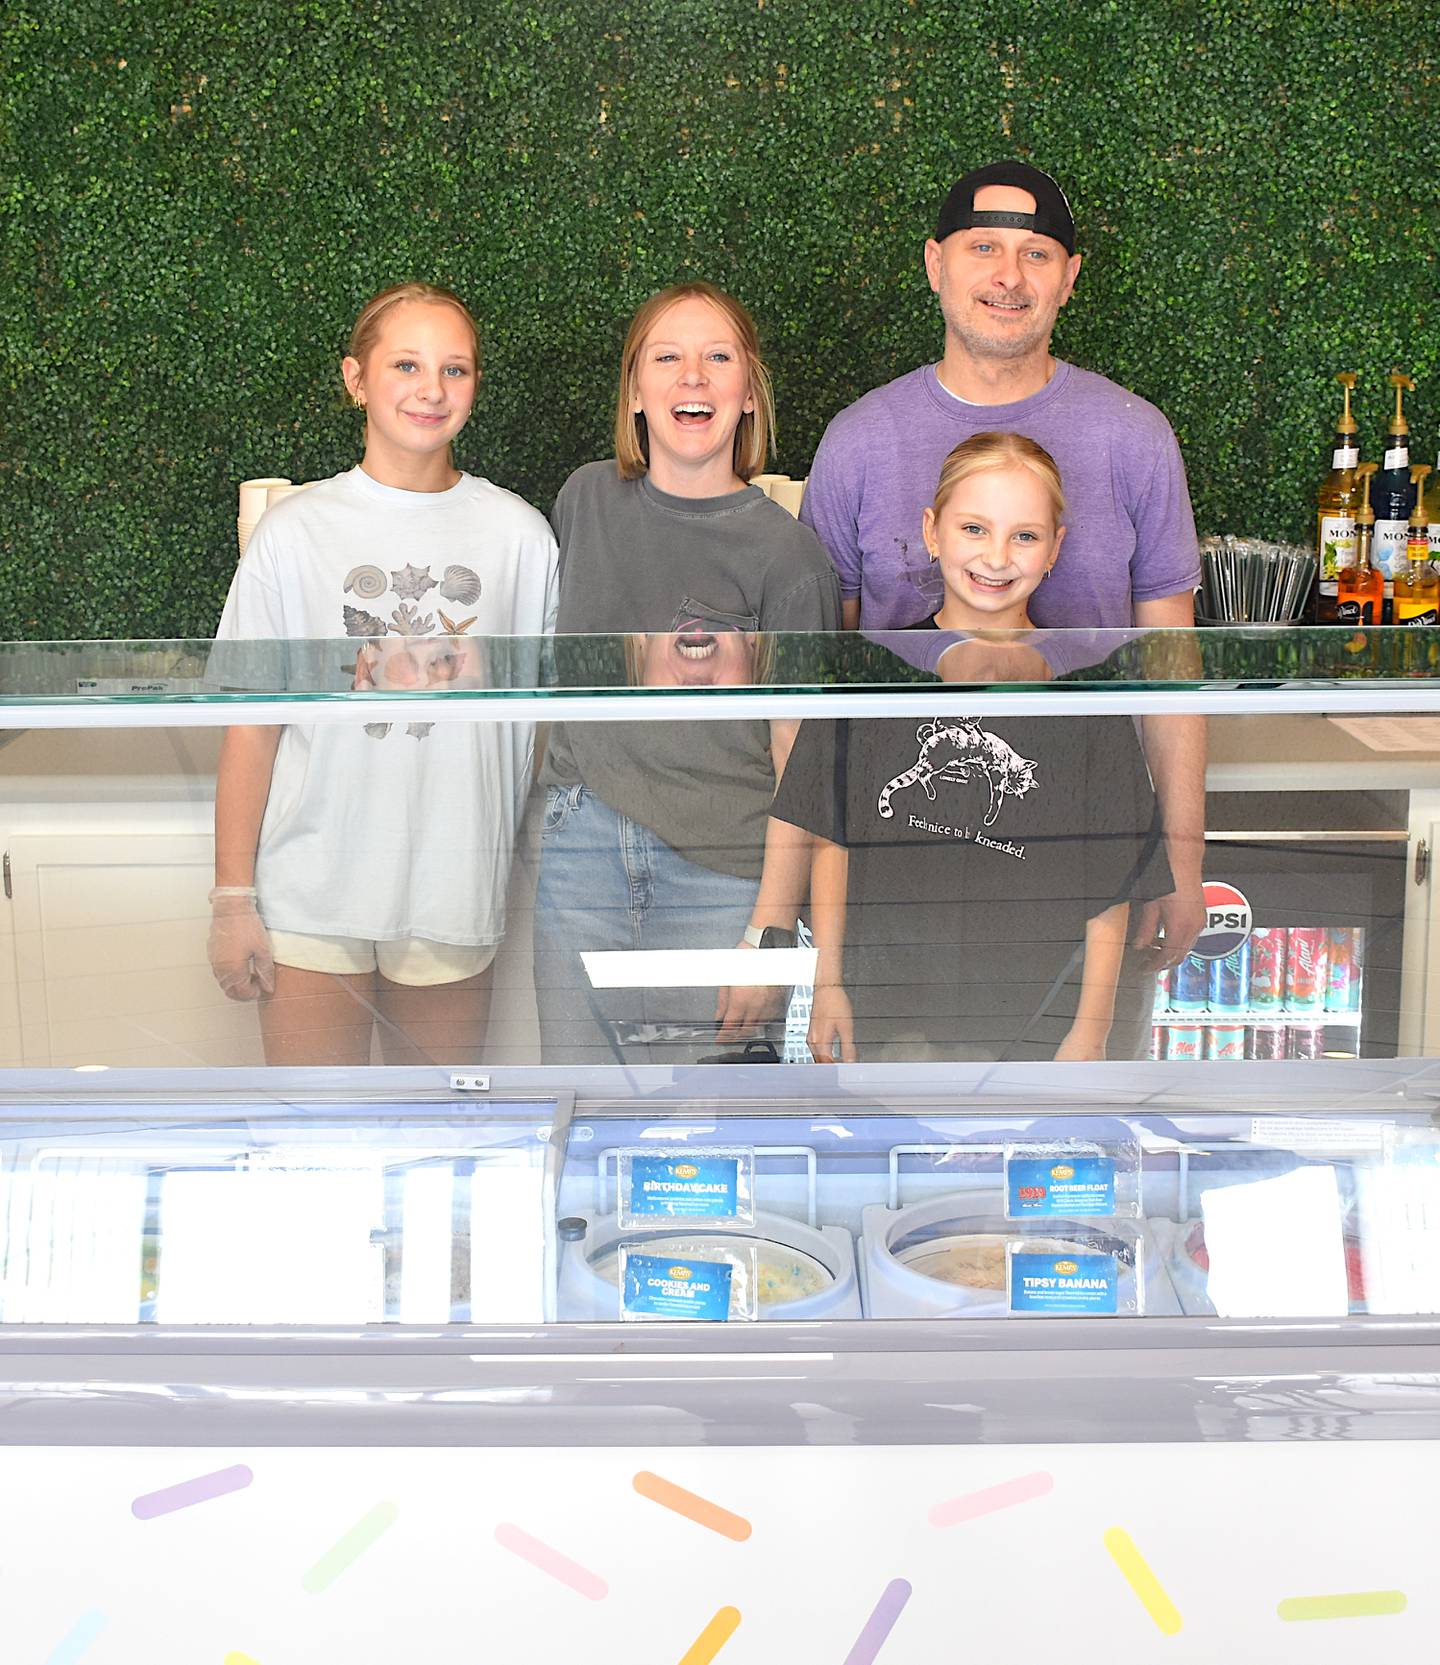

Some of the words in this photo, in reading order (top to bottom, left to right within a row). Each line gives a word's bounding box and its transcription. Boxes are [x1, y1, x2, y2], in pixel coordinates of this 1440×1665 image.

[1329, 529, 1357, 538] MON
[928, 822, 951, 835] nice
[954, 828, 962, 838] to
[974, 831, 1026, 860] kneaded.
[1206, 913, 1247, 928] PSI
[643, 1180, 698, 1193] BIRTHDAY
[699, 1183, 728, 1194] CAKE
[1049, 1184, 1069, 1192] ROOT
[1070, 1184, 1086, 1192] BEER
[1087, 1184, 1109, 1192] FLOAT
[647, 1278, 689, 1290] COOKIES
[689, 1282, 711, 1292] AND
[1023, 1277, 1057, 1288] TIPSY
[1058, 1278, 1108, 1289] BANANA
[661, 1287, 696, 1298] CREAM
